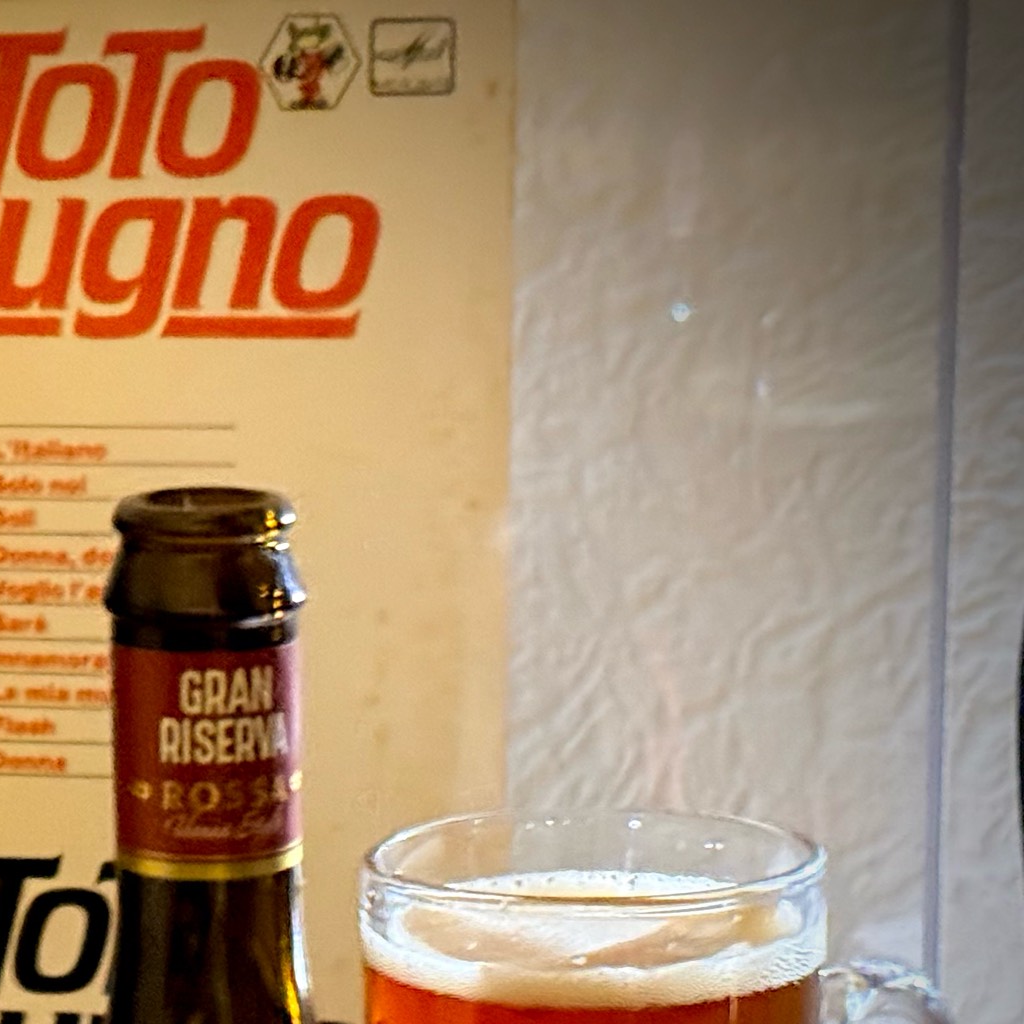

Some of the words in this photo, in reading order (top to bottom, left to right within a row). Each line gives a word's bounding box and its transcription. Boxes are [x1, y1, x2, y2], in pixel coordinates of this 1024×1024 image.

[178, 664, 274, 716] GRAN
[158, 711, 290, 765] RISERVA
[161, 774, 290, 811] ROSSA
